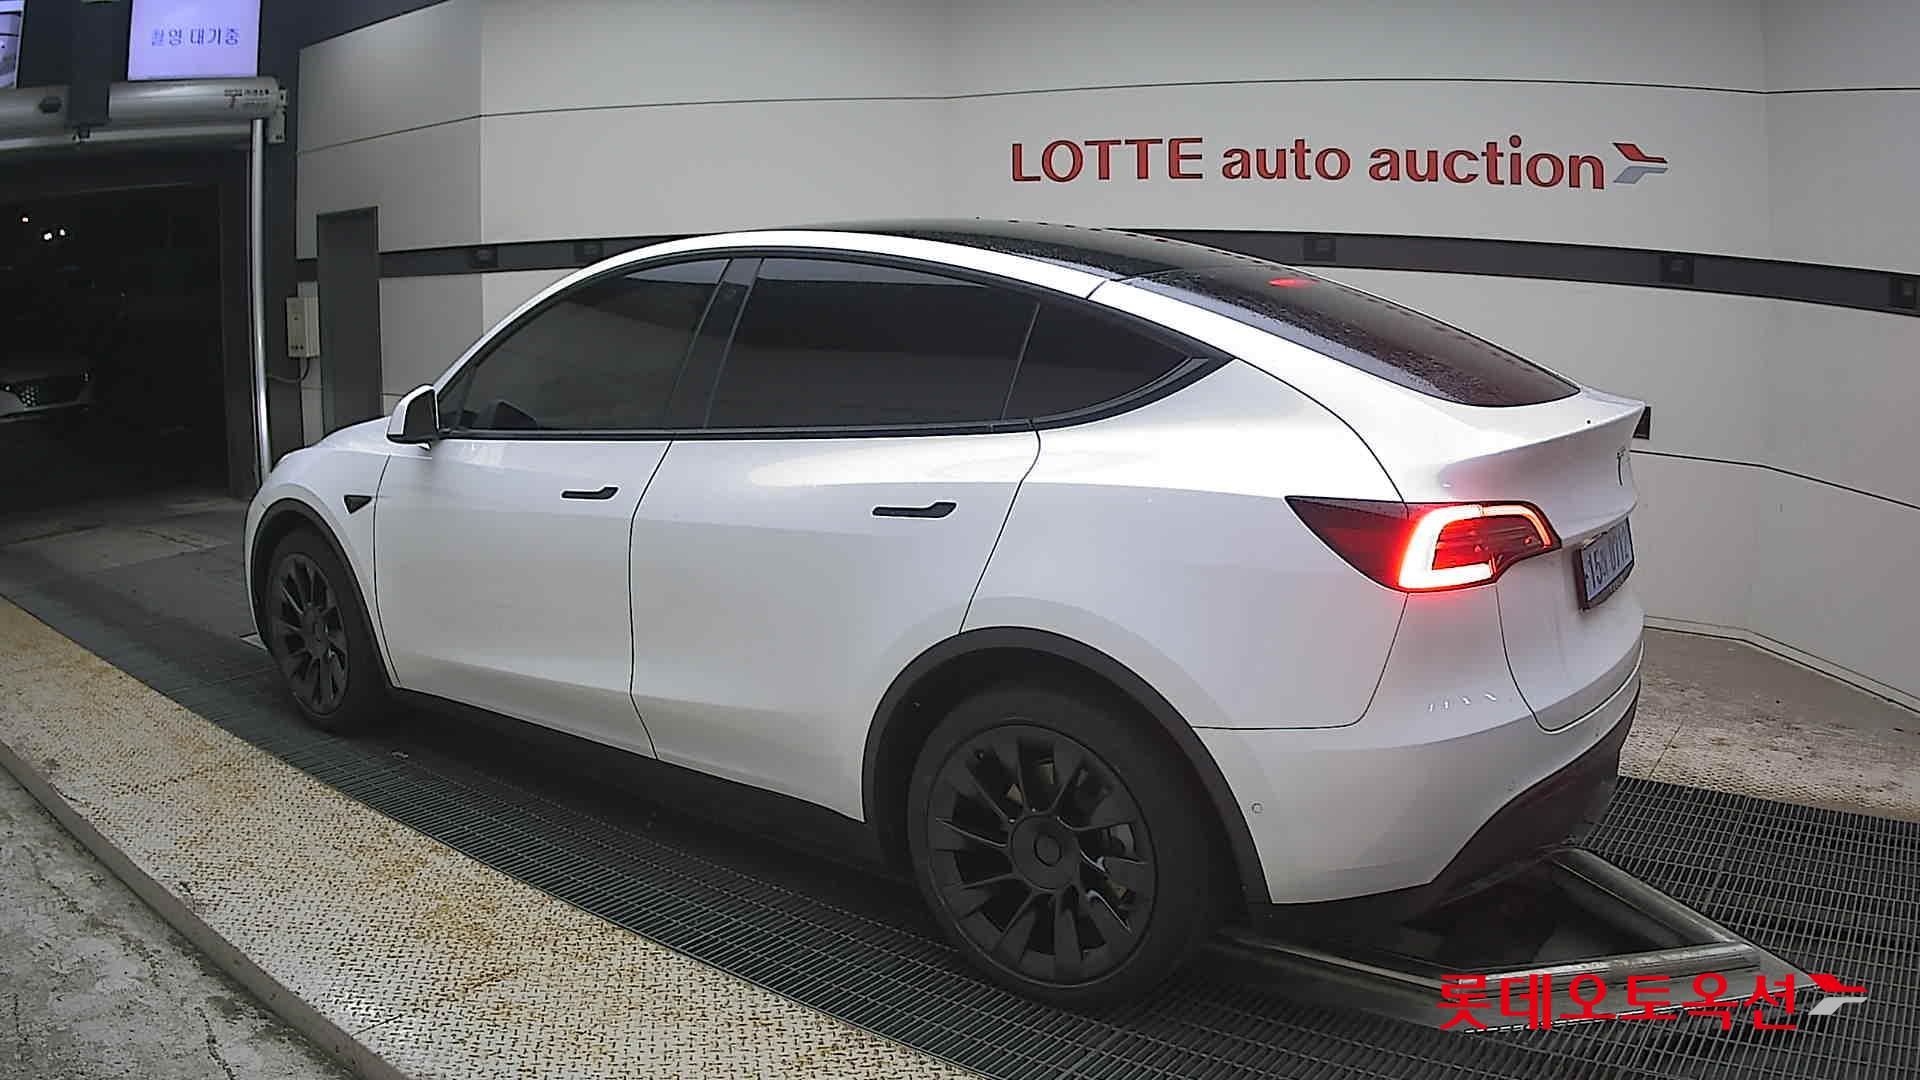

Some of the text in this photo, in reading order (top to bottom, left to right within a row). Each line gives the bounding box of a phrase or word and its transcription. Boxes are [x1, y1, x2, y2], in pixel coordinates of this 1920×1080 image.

[190, 28, 239, 47] 대기중
[1011, 134, 1606, 190] LOTTE auto auction
